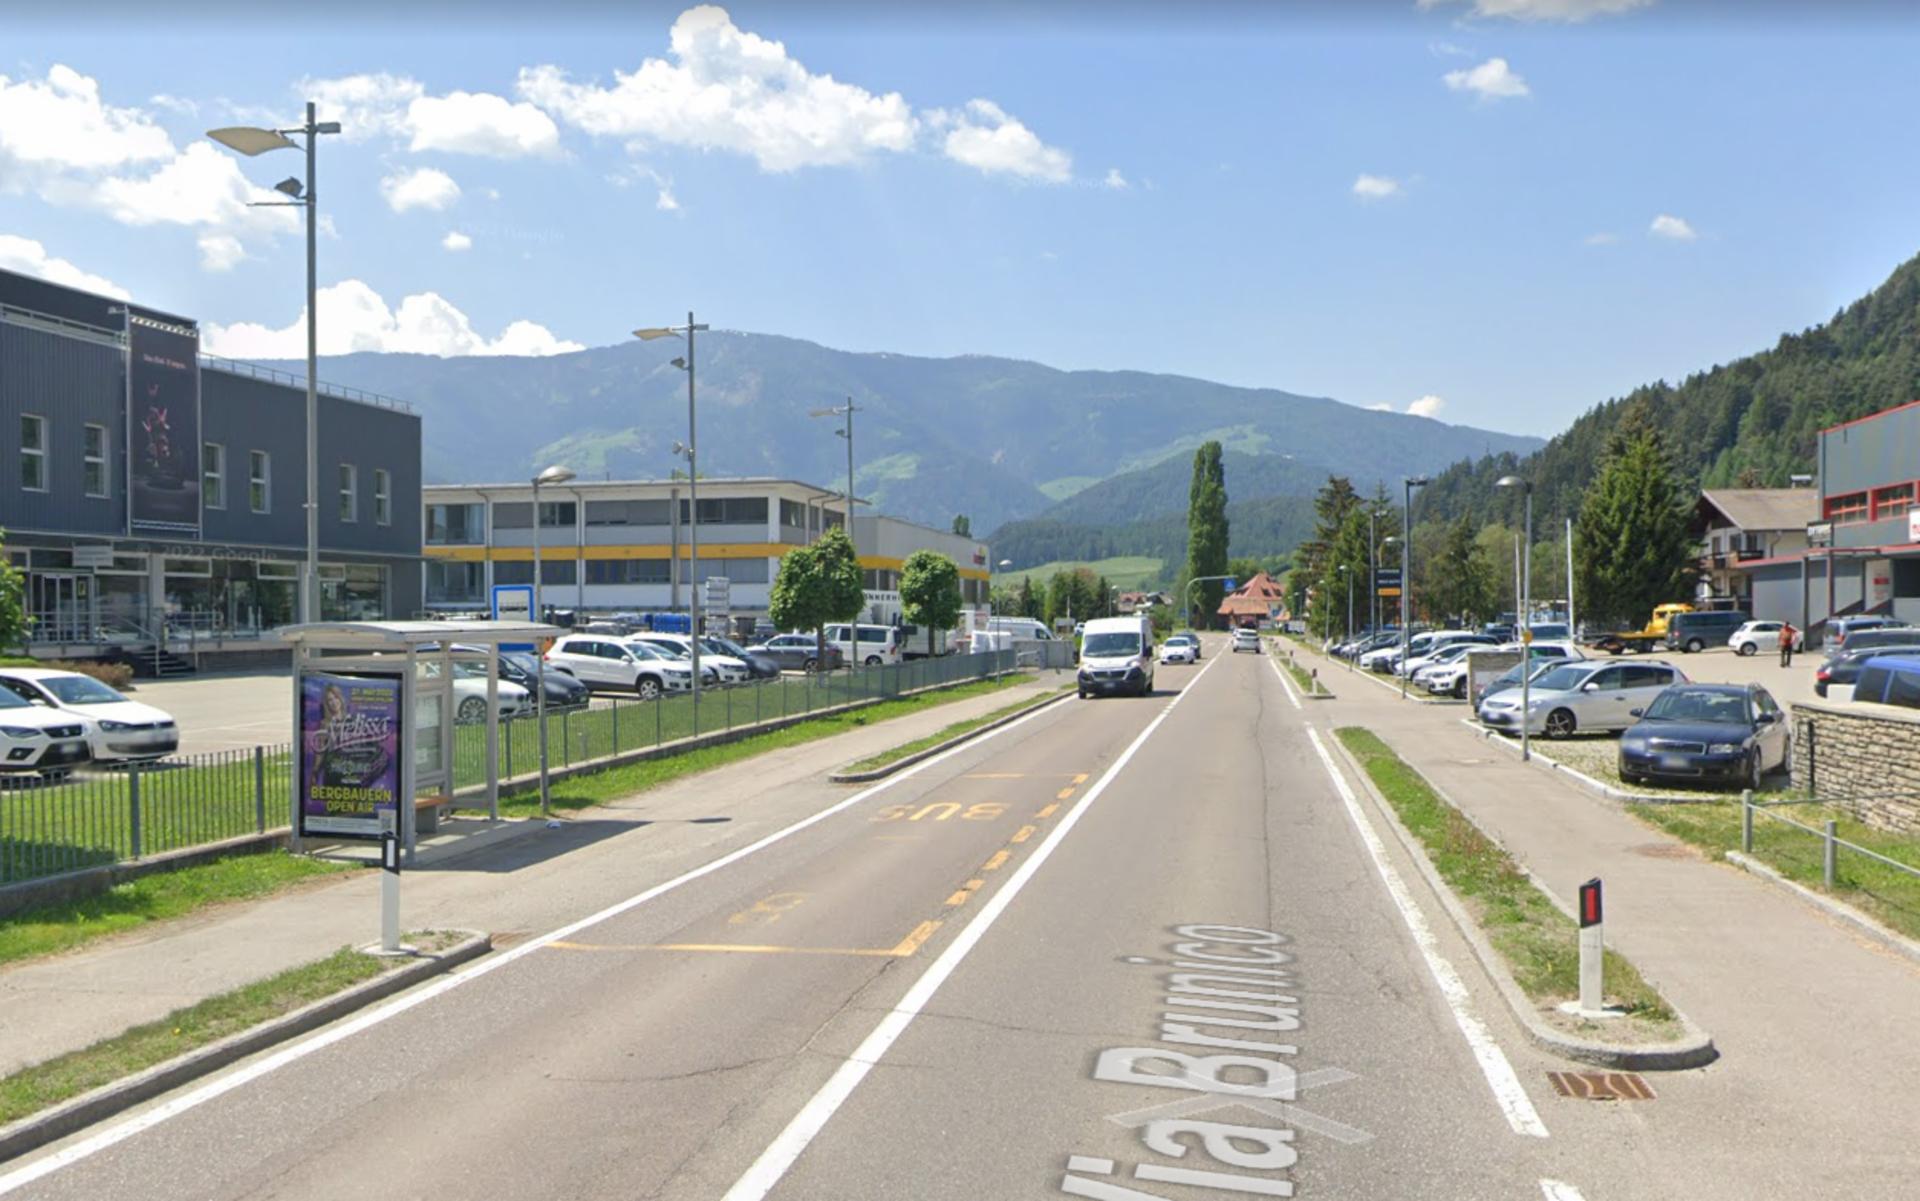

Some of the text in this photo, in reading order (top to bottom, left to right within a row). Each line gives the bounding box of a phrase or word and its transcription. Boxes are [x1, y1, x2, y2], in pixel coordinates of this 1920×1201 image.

[311, 786, 392, 802] BERGBAUERN
[326, 800, 374, 813] OPEN AIR
